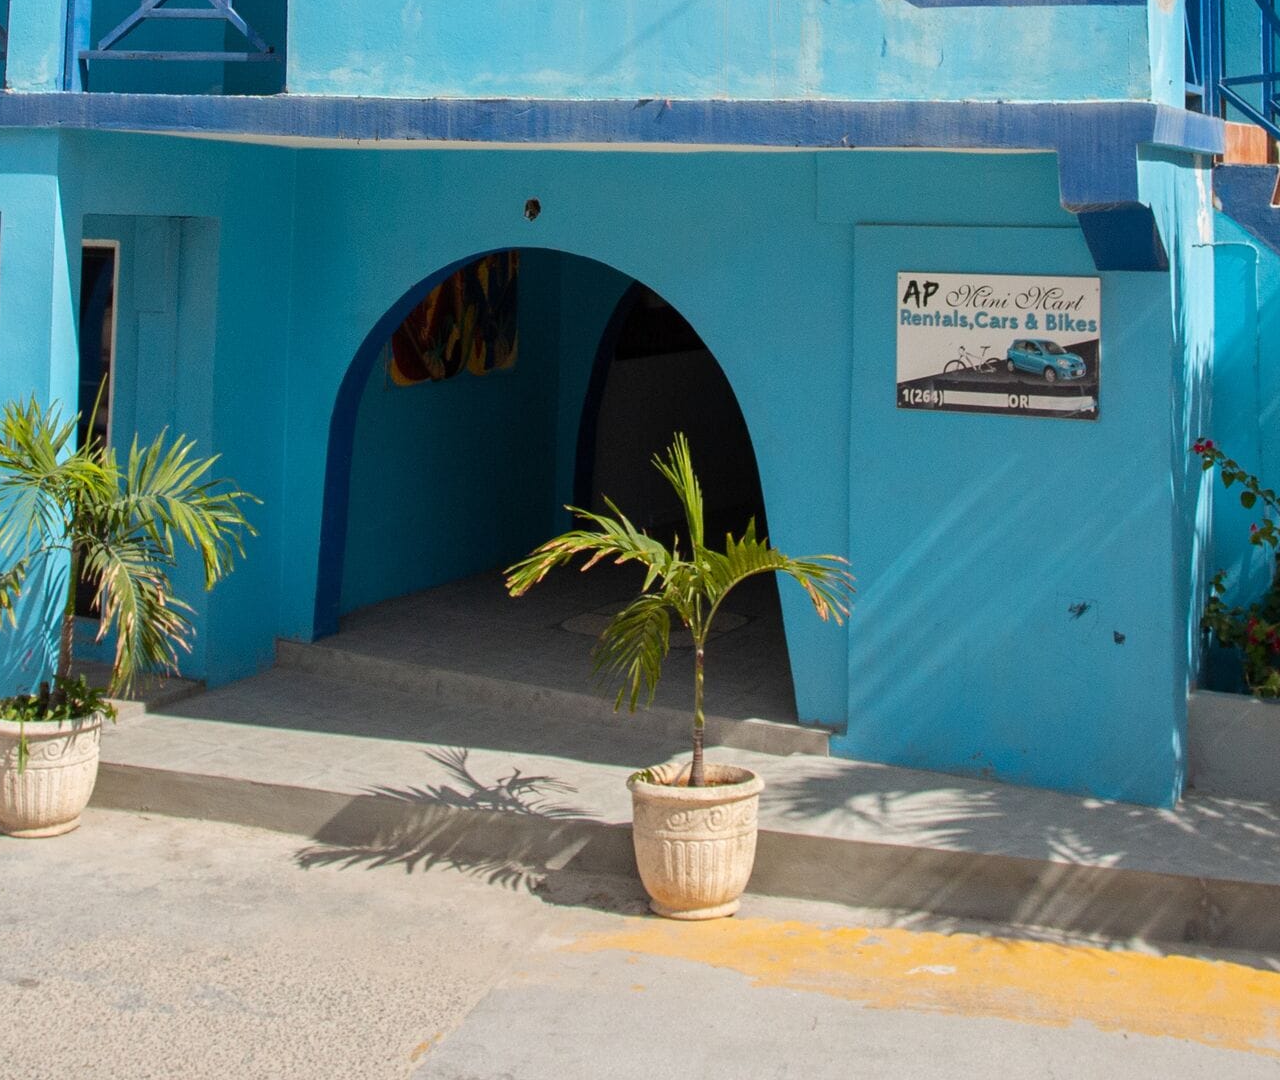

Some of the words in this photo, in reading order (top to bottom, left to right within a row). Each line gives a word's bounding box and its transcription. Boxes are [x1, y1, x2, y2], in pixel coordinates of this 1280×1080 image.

[902, 280, 939, 308] AP
[945, 284, 1010, 310] Mini
[1014, 286, 1085, 312] Mart
[1025, 313, 1038, 330] &
[1046, 314, 1097, 333] Bikes
[902, 388, 944, 406] 1(264)
[1008, 394, 1029, 408] OR
